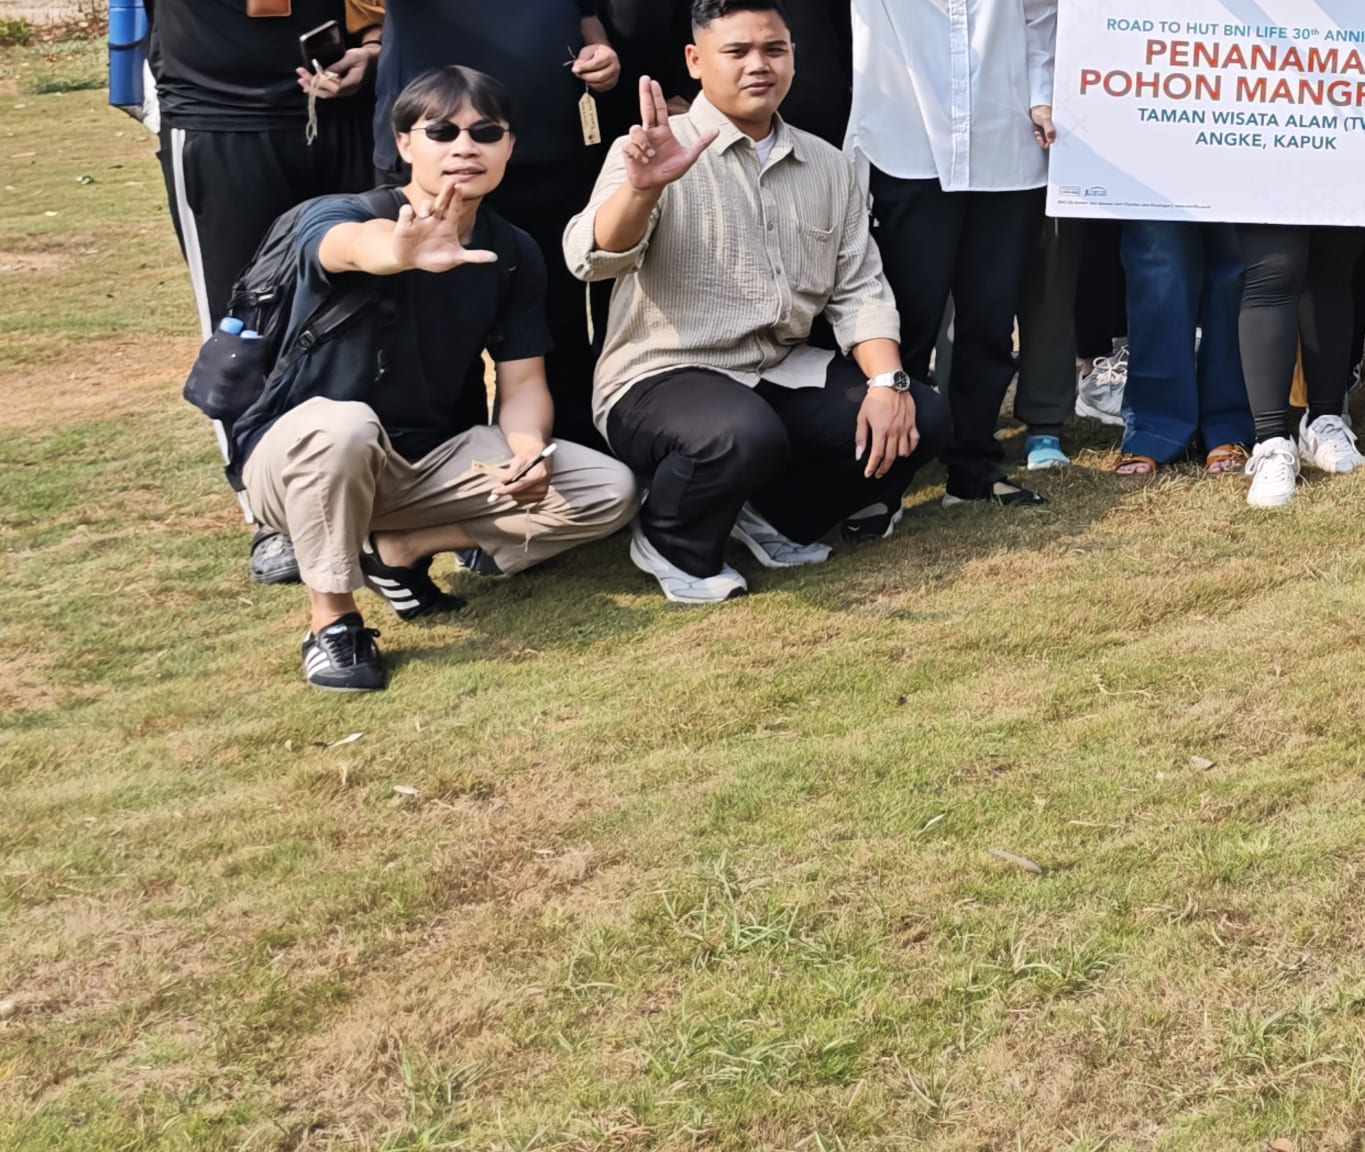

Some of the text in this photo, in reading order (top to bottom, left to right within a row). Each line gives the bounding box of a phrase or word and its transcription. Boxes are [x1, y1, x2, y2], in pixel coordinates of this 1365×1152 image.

[1106, 18, 1154, 33] ROAD
[1159, 21, 1181, 34] TO
[1186, 22, 1220, 36] HUT
[1223, 24, 1251, 38] BNI
[1256, 25, 1288, 39] LIFE
[1292, 28, 1320, 40] 30th
[1079, 69, 1222, 102] POHON
[1138, 108, 1206, 125] TAMAN
[1212, 110, 1280, 128] WISATA
[1285, 114, 1339, 131] ALAM
[1195, 131, 1337, 150] ANGKE, KAPUK
